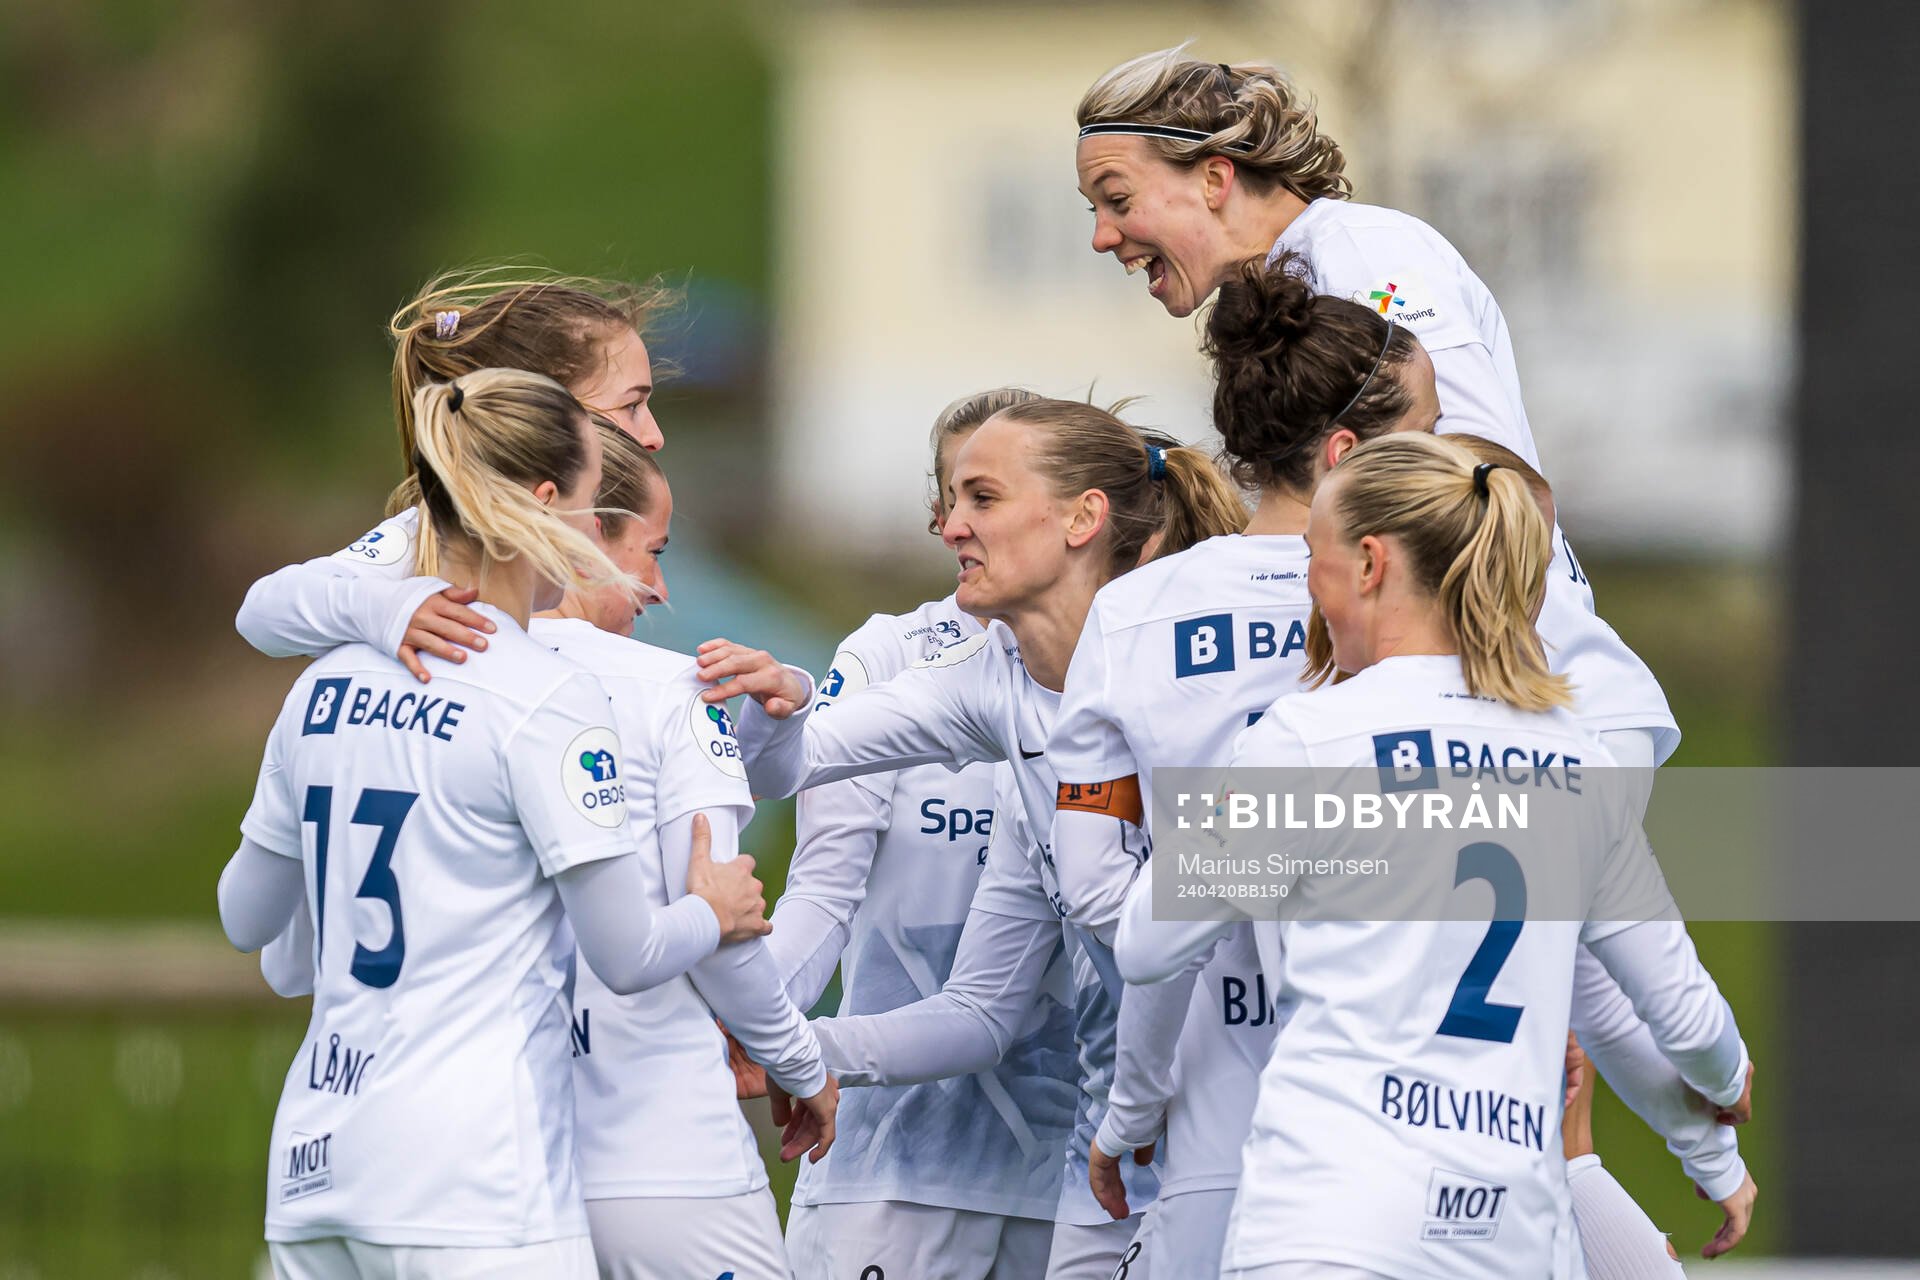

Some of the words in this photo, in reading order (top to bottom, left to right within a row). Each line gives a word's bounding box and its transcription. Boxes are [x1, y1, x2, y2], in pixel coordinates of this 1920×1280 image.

[1395, 308, 1436, 322] Tipping
[347, 687, 466, 742] BACKE
[1447, 739, 1582, 796] BACKE
[582, 785, 625, 809] OBOS
[302, 785, 420, 989] 13
[1435, 841, 1528, 1044] 2
[1222, 973, 1275, 1027] BJ
[1381, 1073, 1545, 1152] BØLVIKEN
[289, 1133, 332, 1178] MOT
[1435, 1185, 1507, 1219] MOT
